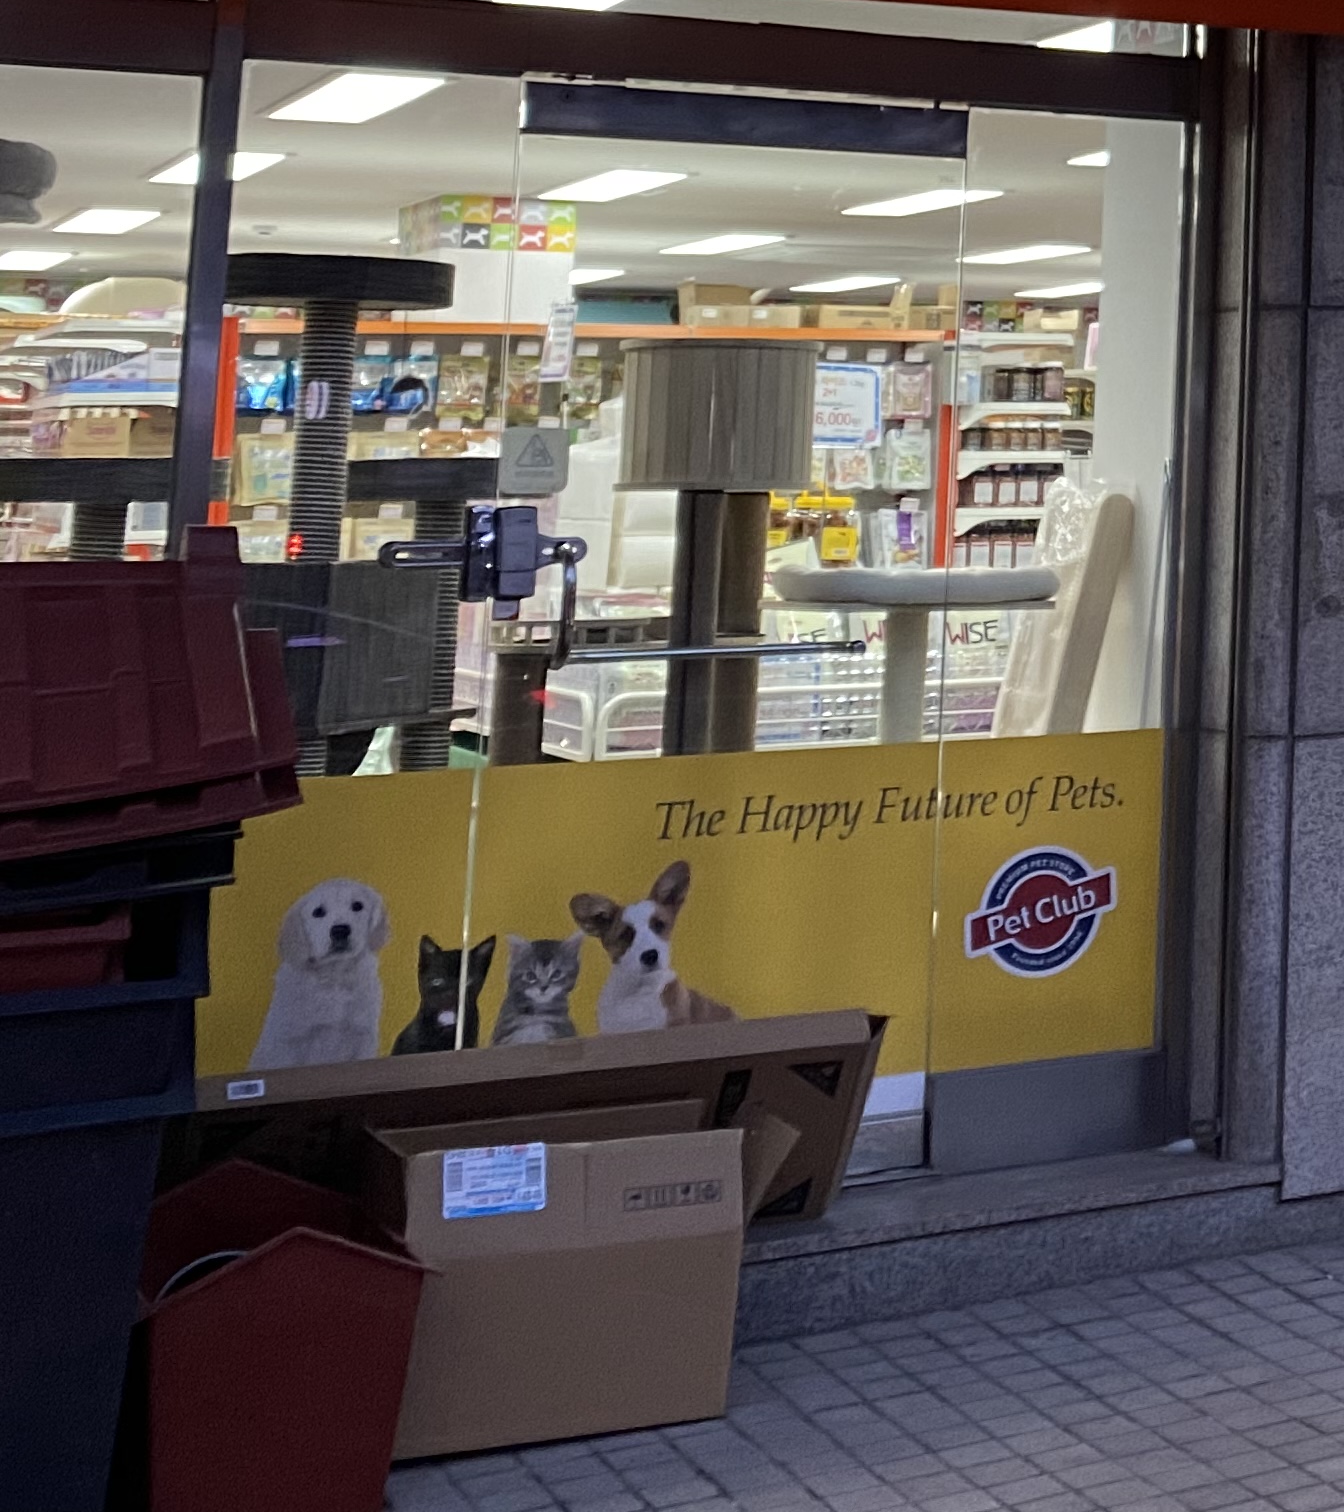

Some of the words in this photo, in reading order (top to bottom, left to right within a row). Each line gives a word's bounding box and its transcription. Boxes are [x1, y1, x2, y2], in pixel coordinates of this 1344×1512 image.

[945, 619, 998, 645] WISE
[655, 798, 726, 841] The
[736, 793, 864, 843] Happy
[873, 786, 999, 824] Future
[1005, 776, 1043, 827] of
[1047, 774, 1125, 813] Pets.
[986, 906, 1032, 941] Pet
[1034, 885, 1097, 924] Club
